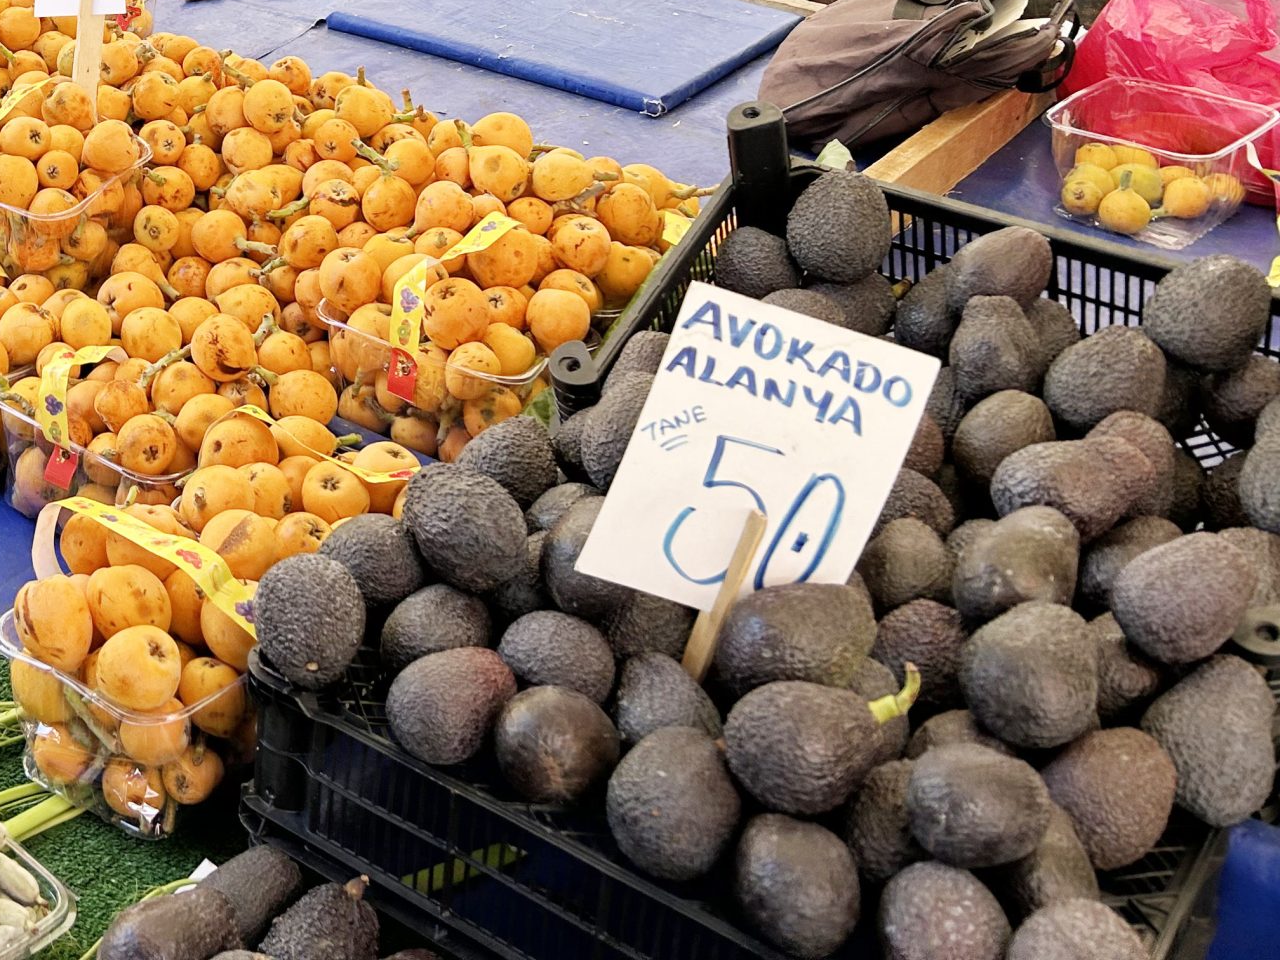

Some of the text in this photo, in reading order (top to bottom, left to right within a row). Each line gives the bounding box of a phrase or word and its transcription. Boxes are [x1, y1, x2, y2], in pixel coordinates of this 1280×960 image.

[666, 346, 864, 436] ALANYA
[681, 300, 913, 408] AVOKADO
[640, 405, 708, 441] TANE
[663, 435, 847, 591] 50
